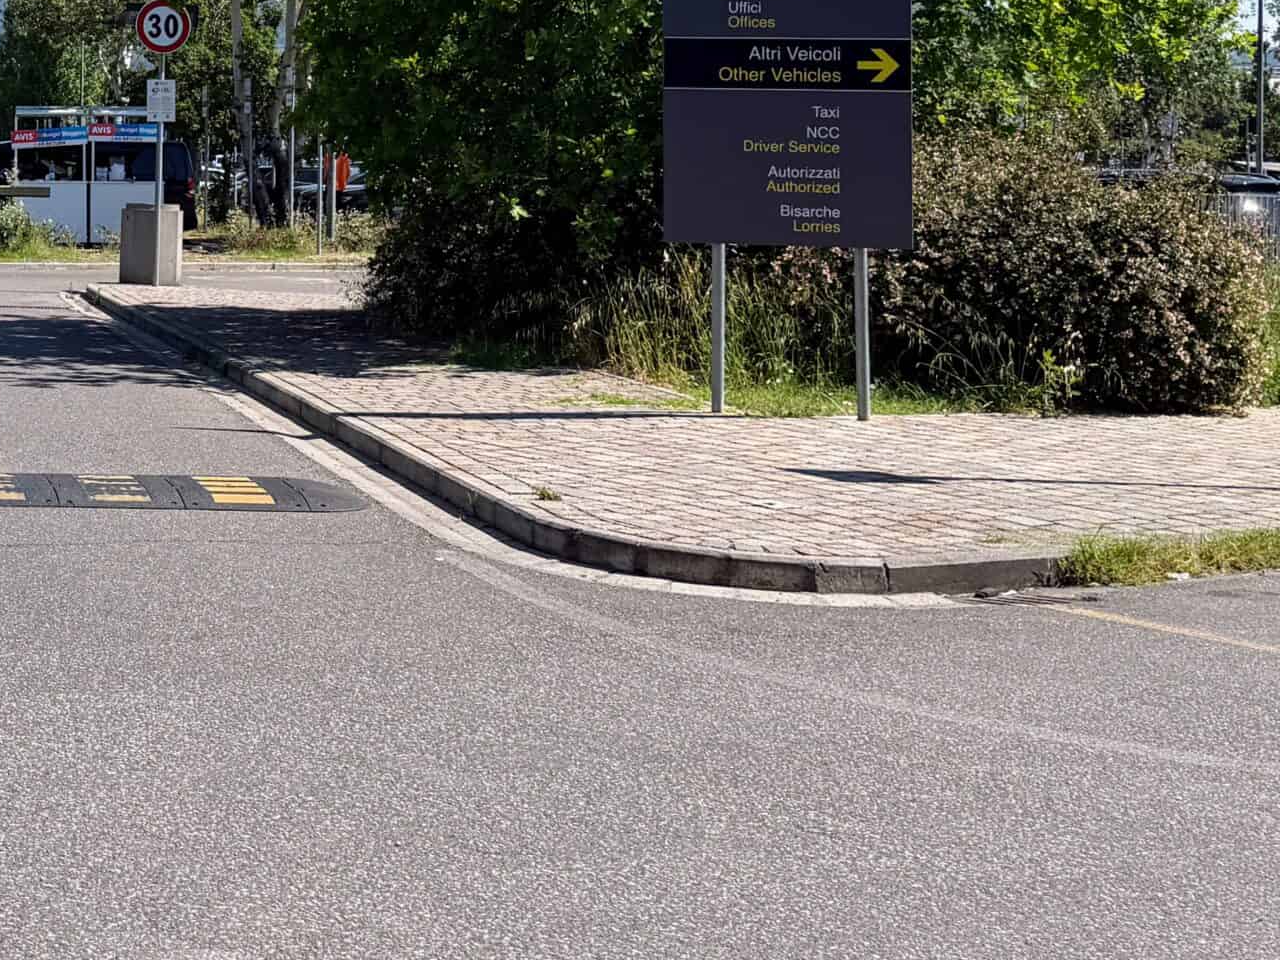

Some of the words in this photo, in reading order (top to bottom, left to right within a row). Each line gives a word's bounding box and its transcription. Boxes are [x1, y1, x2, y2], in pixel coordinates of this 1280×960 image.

[728, 1, 761, 13] Uffici
[148, 14, 178, 38] 30
[728, 16, 776, 29] Offices
[749, 46, 781, 61] Altri
[786, 46, 841, 61] Veicoli
[719, 67, 765, 82] Other
[771, 67, 842, 82] Vehicles
[812, 106, 840, 118] Taxi
[91, 125, 112, 134] AVIS
[806, 127, 840, 138] NCC
[14, 133, 33, 141] AVIS
[744, 140, 784, 152] Driver
[788, 141, 840, 154] Service
[768, 166, 840, 179] Autorizzati
[766, 181, 840, 194] Authorized
[780, 204, 841, 218] Bisarche
[793, 220, 841, 233] Lorries
